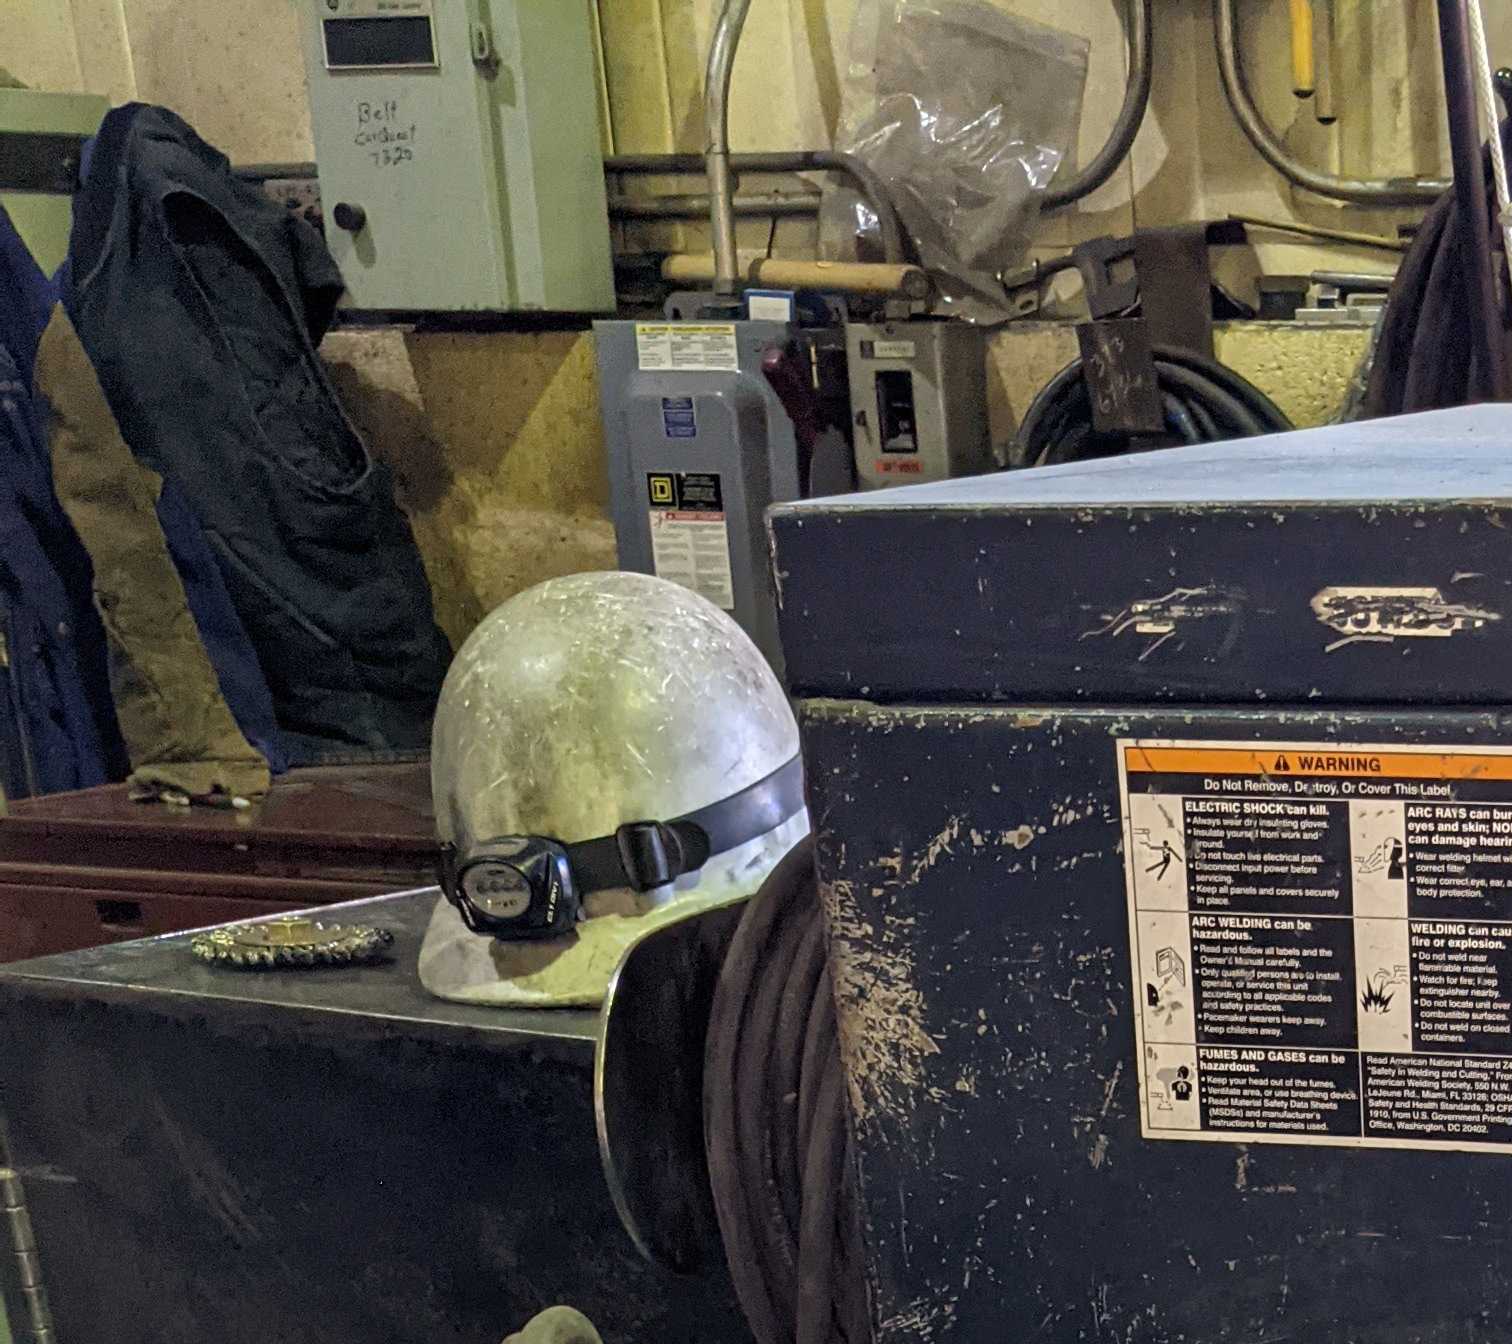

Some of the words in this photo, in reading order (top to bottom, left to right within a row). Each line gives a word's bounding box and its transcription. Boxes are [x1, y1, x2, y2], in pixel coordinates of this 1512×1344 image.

[1298, 756, 1382, 773] WARNING
[1204, 778, 1221, 791] Do
[1223, 779, 1242, 791] Not
[1245, 779, 1293, 795] Remove,
[1295, 781, 1340, 797] Detroy,
[1342, 781, 1356, 794] Or
[1359, 782, 1392, 795] Cover
[1394, 782, 1418, 795] This
[1185, 802, 1242, 814] ELECTRIC
[1244, 803, 1285, 814] SHOCK
[1287, 806, 1308, 815] can
[1310, 804, 1329, 815] kill.
[1408, 806, 1434, 818] ARC
[1436, 807, 1468, 819] RAYS
[1470, 810, 1491, 819] can
[1408, 823, 1435, 834] eyes
[1437, 821, 1459, 832] and
[1461, 821, 1490, 835] skin;
[1408, 836, 1429, 845] can
[1432, 834, 1477, 849] damage
[1192, 916, 1217, 928] ARC
[1219, 917, 1273, 929] WELDING
[1275, 921, 1295, 930] can
[1297, 919, 1311, 930] be
[1411, 923, 1466, 936] WELDING
[1469, 927, 1490, 936] can
[1192, 928, 1252, 940] hazardous.
[1412, 936, 1431, 947] fire
[1433, 939, 1446, 948] or
[1448, 936, 1507, 952] explosion.
[1200, 1049, 1239, 1061] FUMES
[1241, 1051, 1266, 1061] AND
[1268, 1051, 1307, 1063] GASES
[1310, 1054, 1330, 1063] can
[1332, 1053, 1346, 1064] be
[1200, 1061, 1260, 1073] hazardous.
